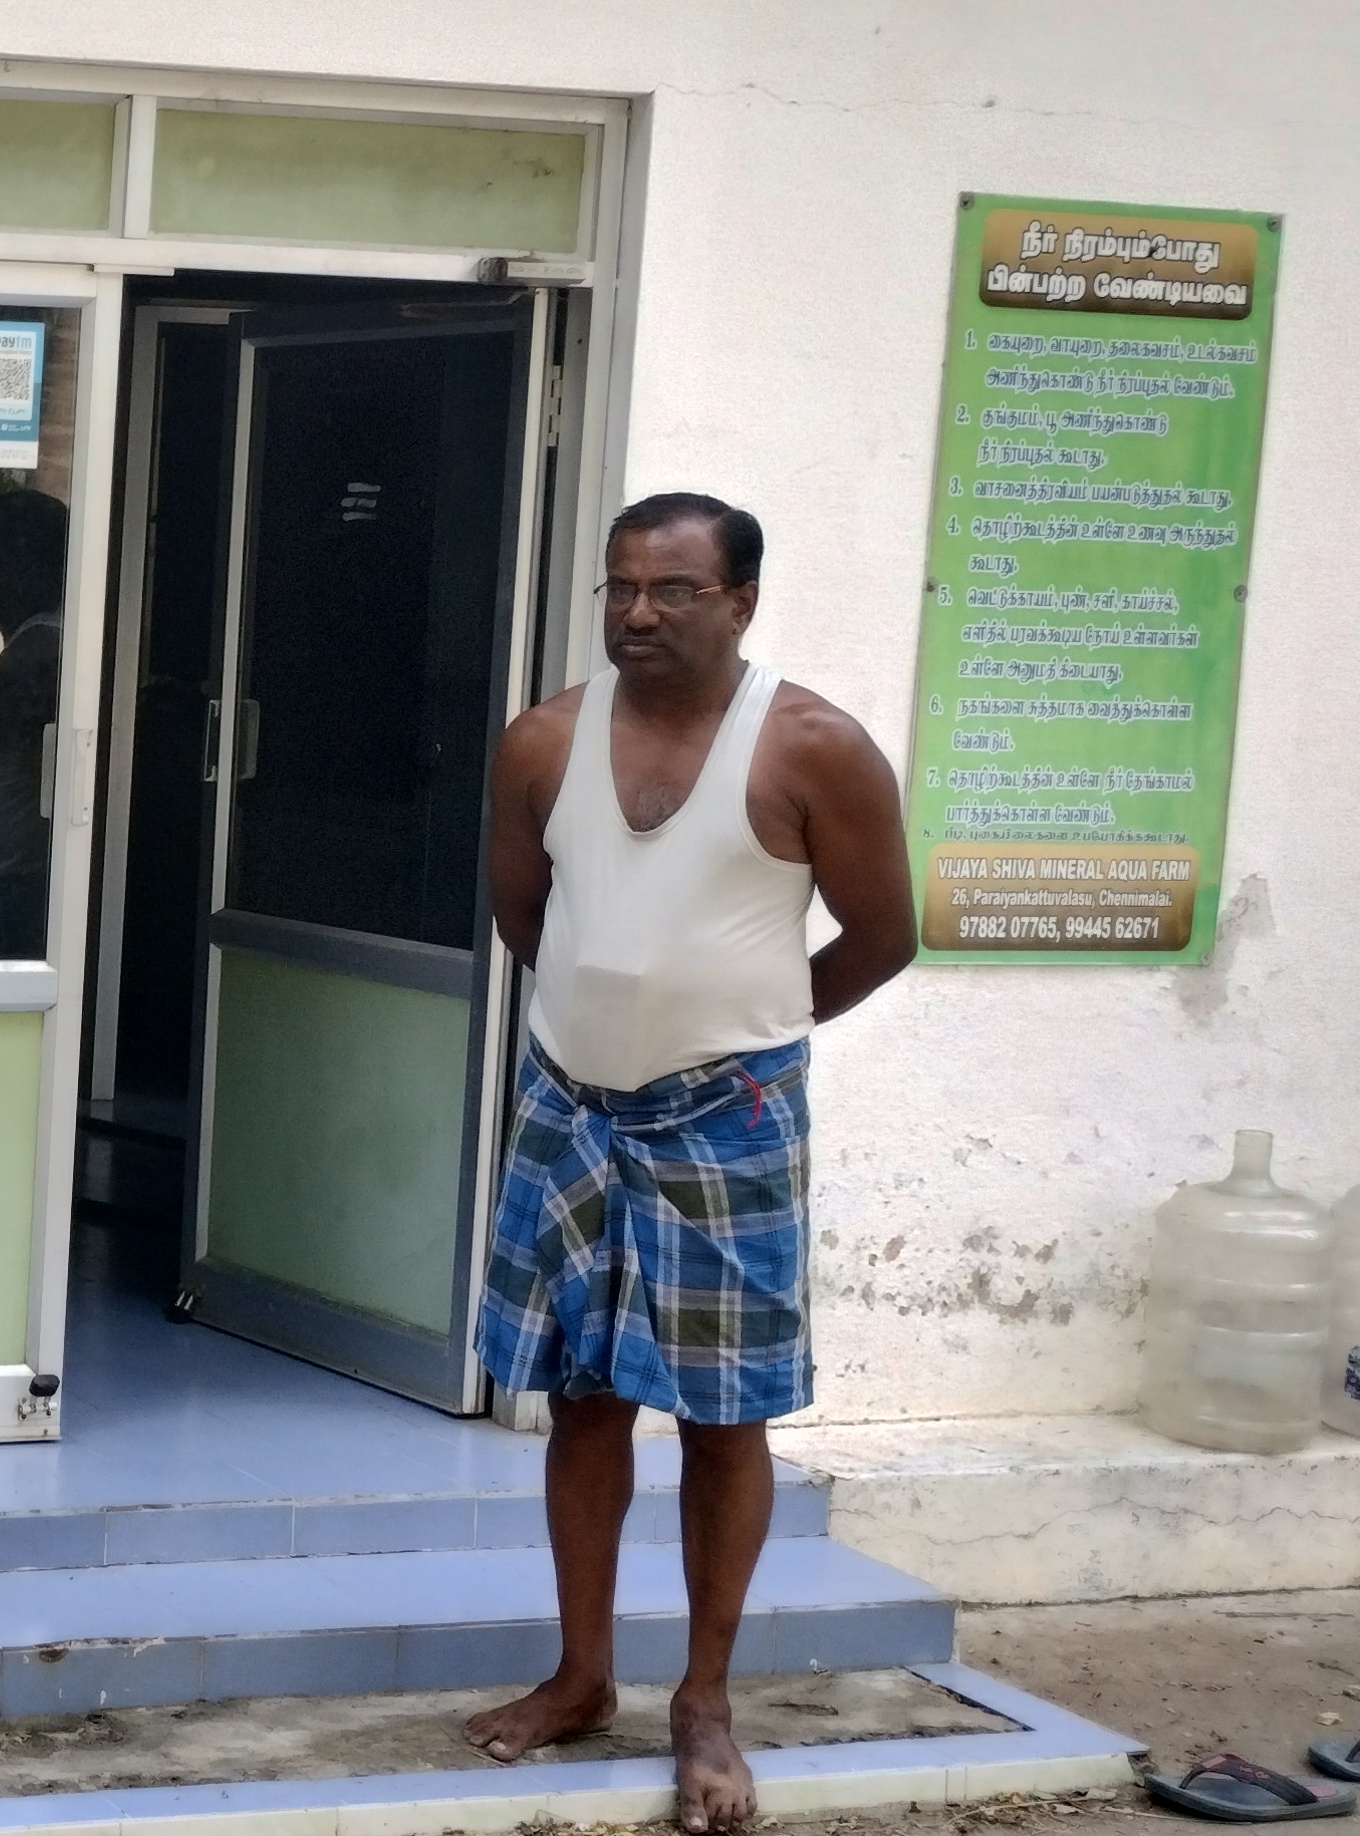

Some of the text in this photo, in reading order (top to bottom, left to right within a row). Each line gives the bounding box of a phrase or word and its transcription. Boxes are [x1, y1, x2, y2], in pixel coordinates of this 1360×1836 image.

[1020, 219, 1221, 274] நீர் நிரம்பும்போது
[986, 261, 1248, 306] பின்பற்ற வேண்டியவை
[965, 329, 976, 349] 1.
[1095, 368, 1114, 395] நீர்
[956, 404, 970, 423] 2.
[978, 438, 997, 465] நீர்
[949, 476, 962, 495] 3.
[947, 516, 960, 534] 4.
[930, 694, 943, 714] 6.
[927, 768, 940, 786] 7.
[1104, 766, 1123, 792] நீர்
[937, 857, 1191, 882] VIJAYA SHIVA MINERAL AQUA FARM
[951, 887, 1173, 910] 26, Paraiyankattuvalasu, Chennimalai.
[959, 914, 1160, 942] 97882 07765, 99445 62671
